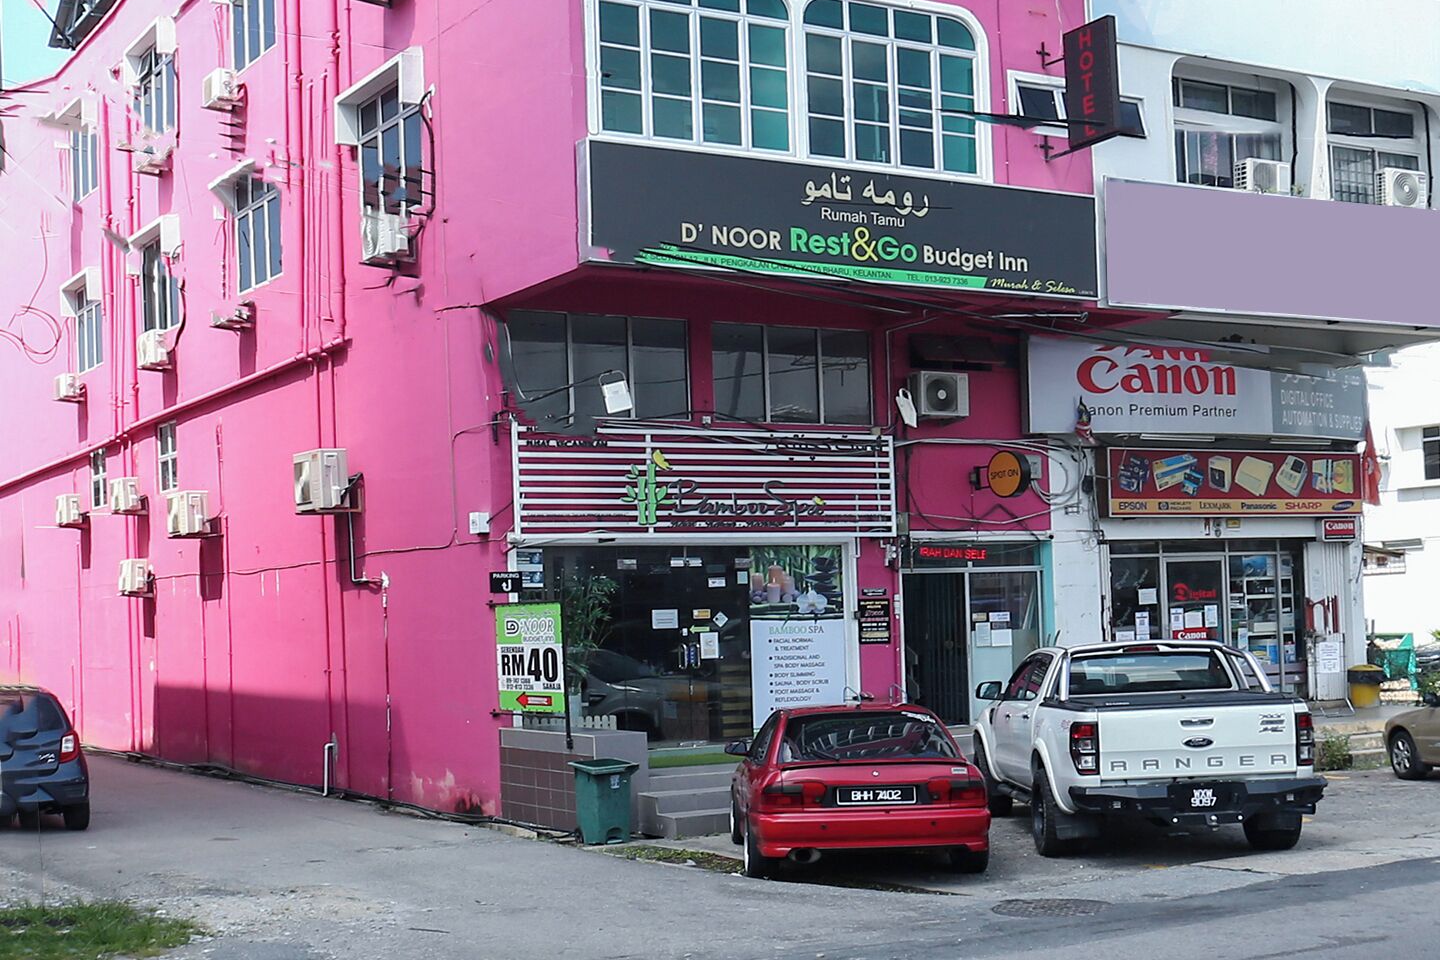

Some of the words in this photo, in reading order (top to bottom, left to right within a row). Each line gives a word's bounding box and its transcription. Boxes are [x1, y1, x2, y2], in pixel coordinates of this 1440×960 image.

[1078, 28, 1097, 137] HOTEL
[821, 207, 867, 224] Rumah
[871, 212, 905, 228] Tamu
[711, 225, 782, 251] NOOR
[923, 245, 994, 272] Budget
[999, 252, 1029, 273] Inn
[990, 277, 1029, 290] Murah
[1076, 355, 1236, 396] Canon
[1089, 406, 1124, 417] anon
[1129, 404, 1188, 417] Premium
[1192, 404, 1237, 418] Partner
[990, 470, 1006, 481] SPOT
[1007, 468, 1019, 478] ON
[1118, 502, 1148, 511] EPSON
[1240, 502, 1277, 510] Panasonic
[1285, 502, 1322, 510] SHARP
[1325, 521, 1354, 531] Canon
[1173, 582, 1217, 601] Digital
[768, 625, 807, 635] BAMBOO
[808, 625, 824, 634] SPA
[1177, 631, 1207, 639] Canon
[1110, 754, 1288, 772] RANGER
[851, 790, 873, 801] BHH
[875, 789, 902, 800] 7402
[1193, 789, 1213, 799] WXW
[1191, 797, 1217, 807] 9097
